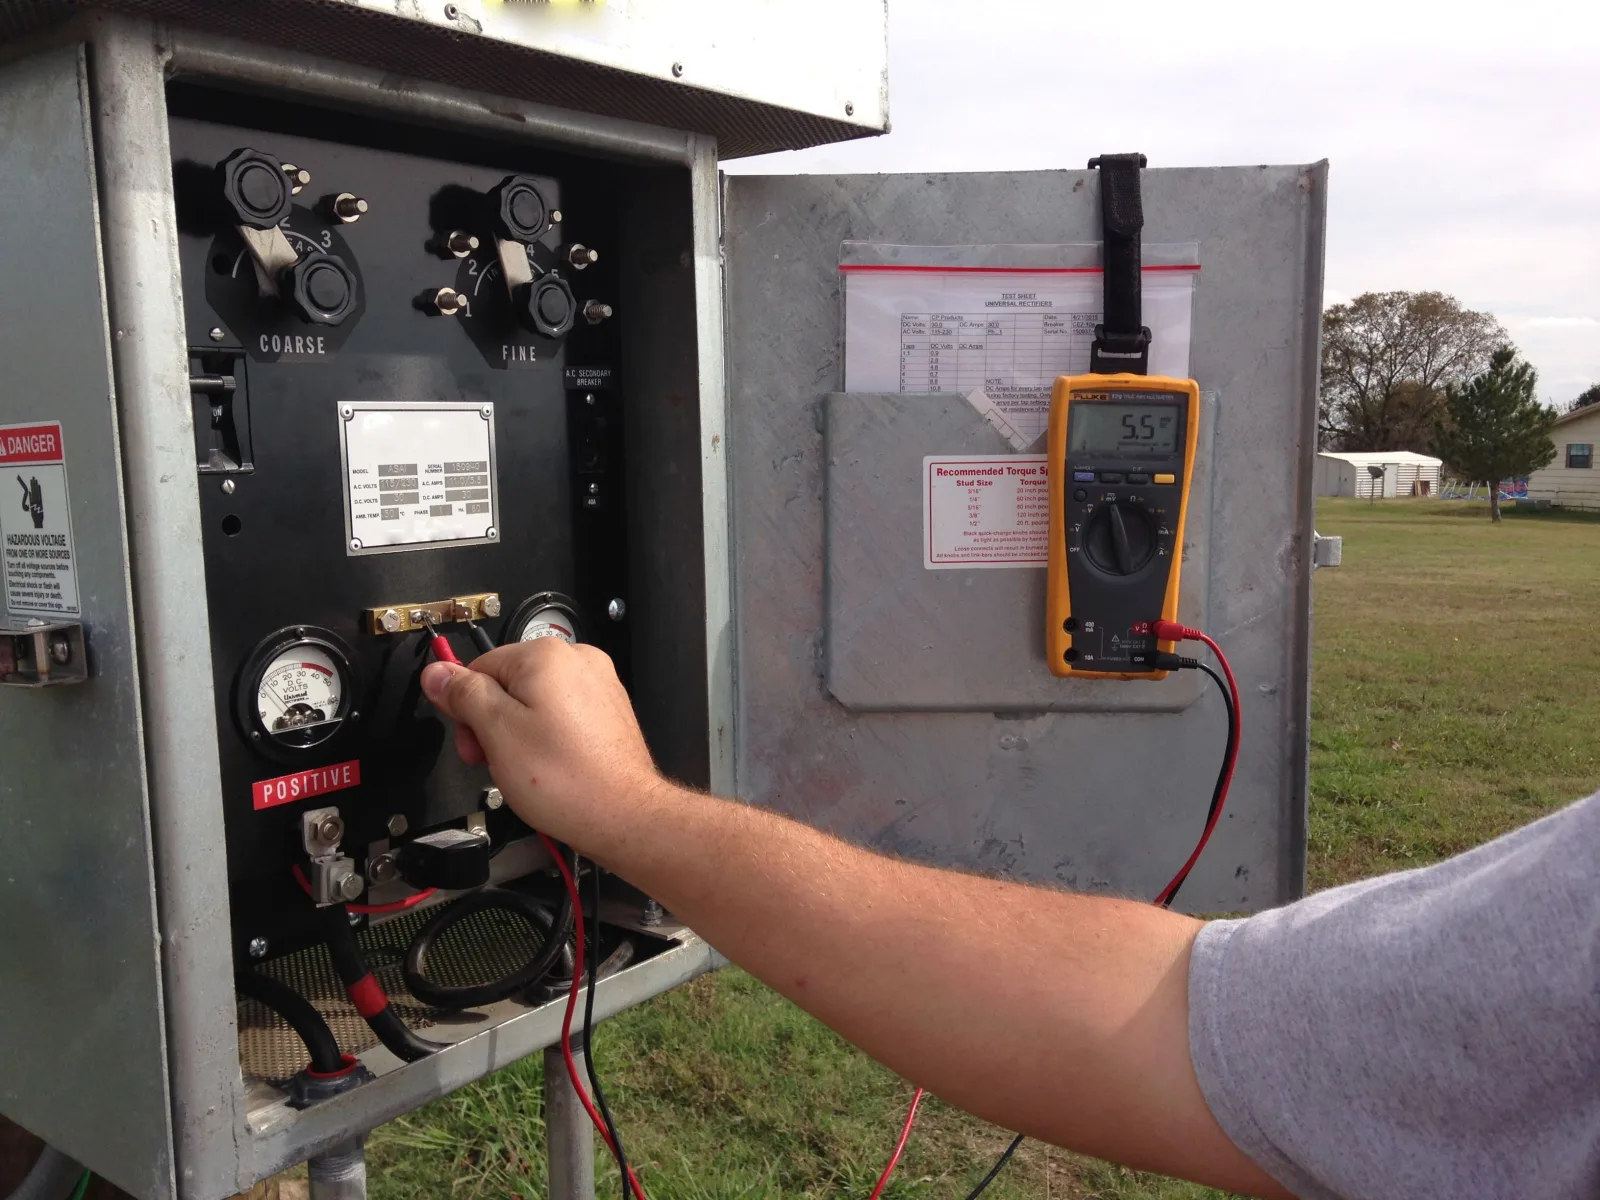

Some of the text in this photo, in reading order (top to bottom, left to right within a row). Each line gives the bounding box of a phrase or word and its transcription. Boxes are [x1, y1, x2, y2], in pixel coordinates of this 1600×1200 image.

[321, 230, 331, 248] 3
[526, 244, 535, 257] 4
[468, 260, 478, 275] 2
[465, 302, 472, 317] 1
[260, 334, 325, 354] COARSE
[502, 345, 536, 361] FINE
[212, 408, 222, 416] ON
[1122, 414, 1154, 440] 5.5
[8, 434, 55, 454] DANGER
[937, 467, 1037, 476] Recommended Torque
[1020, 479, 1046, 487] Torque
[462, 490, 471, 498] 30
[7, 534, 66, 546] HAZARDOUS VOLTAGE
[6, 549, 70, 559] FROM ONE OR MORE SOURCES
[26, 562, 40, 571] voltage
[283, 684, 308, 693] VOLTS
[323, 678, 331, 687] 50
[284, 691, 308, 700] Universal
[263, 765, 351, 803] POSITIVE
